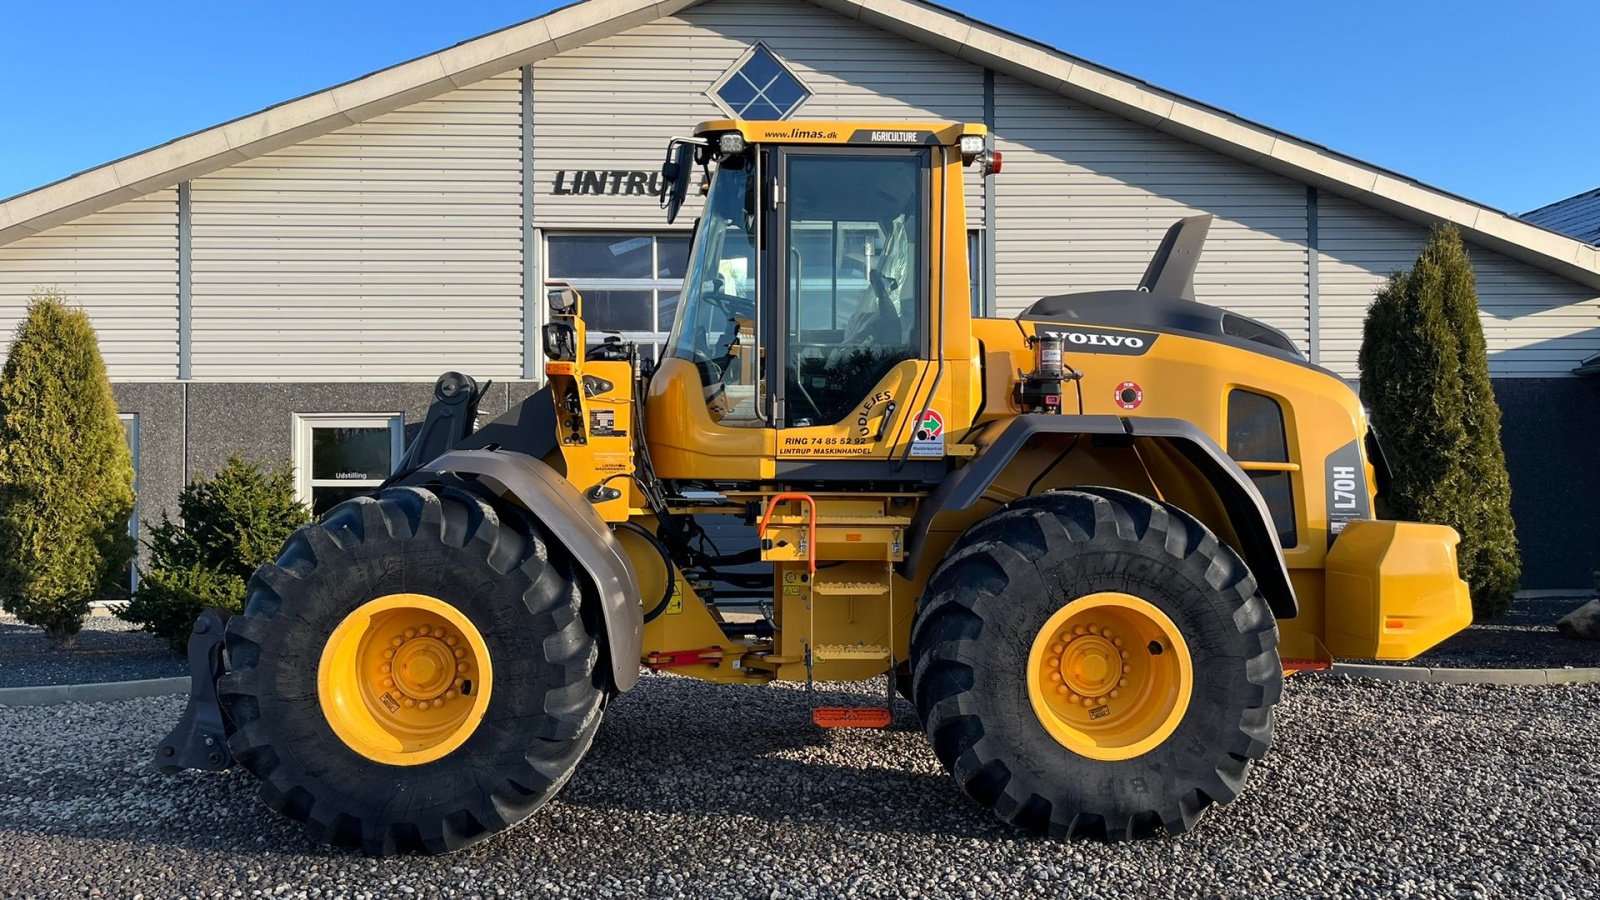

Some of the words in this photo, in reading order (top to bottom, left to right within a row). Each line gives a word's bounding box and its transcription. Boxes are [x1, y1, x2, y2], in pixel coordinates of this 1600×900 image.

[764, 128, 838, 139] www.limas.dk
[871, 131, 917, 142] AGRICULTURE
[551, 170, 665, 196] LINTRU
[858, 390, 891, 436] UDLEJES
[335, 472, 367, 480] Udstilling
[1333, 466, 1356, 509] L70H
